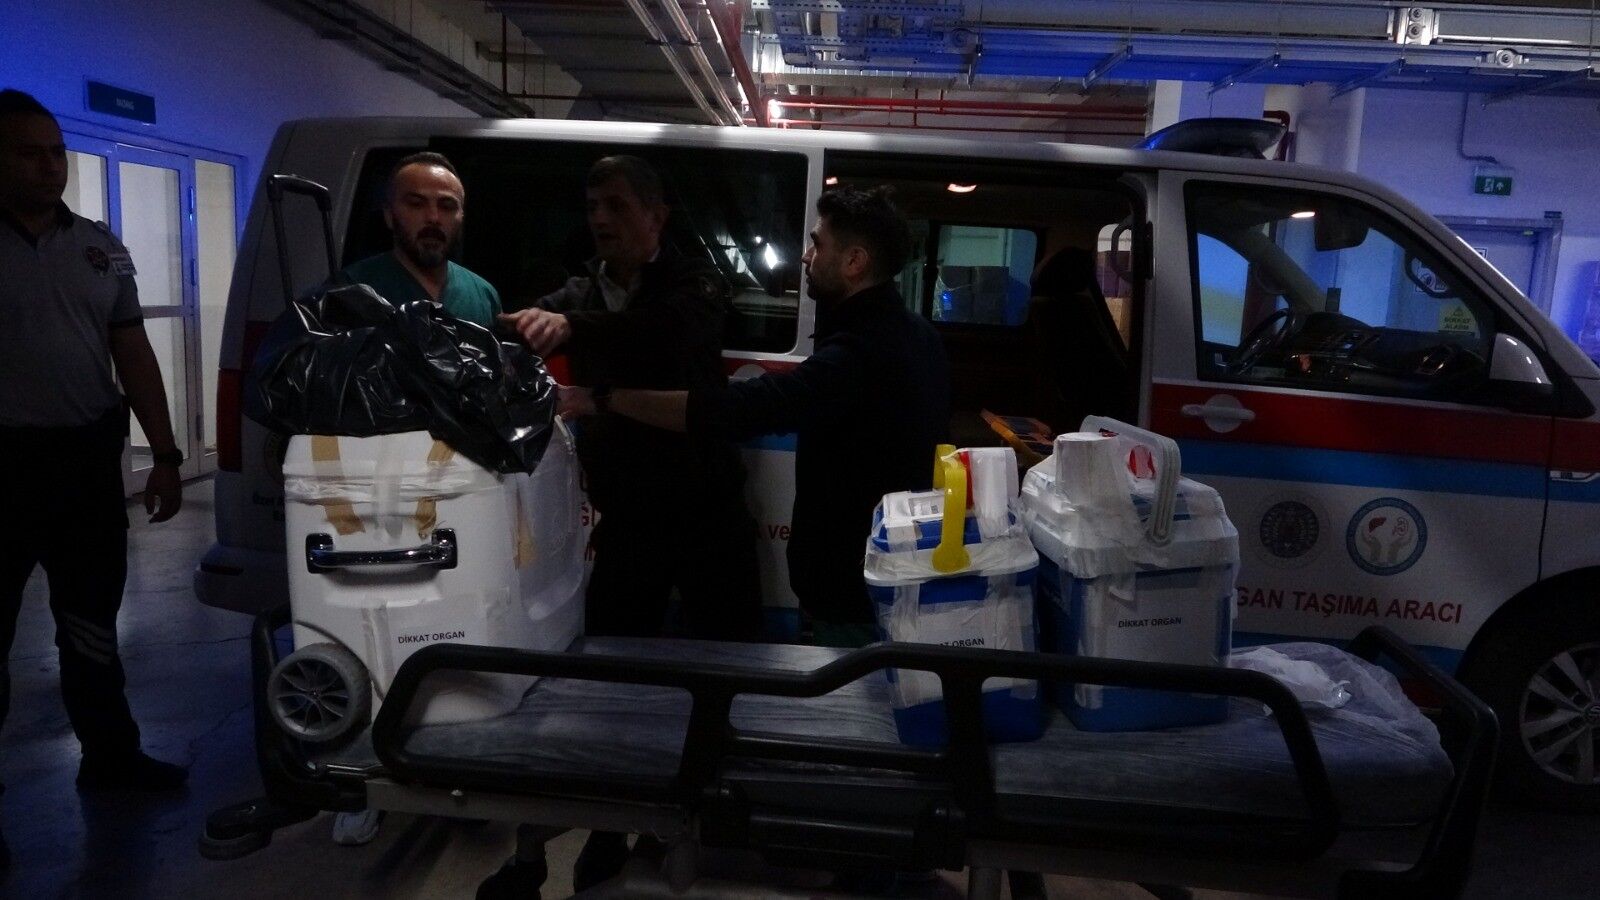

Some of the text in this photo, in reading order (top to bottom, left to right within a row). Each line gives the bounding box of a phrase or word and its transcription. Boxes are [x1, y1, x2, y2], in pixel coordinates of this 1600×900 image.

[1237, 586, 1463, 624] GAN TAŞIMA ARACI
[1151, 617, 1182, 626] ORGAN
[398, 631, 465, 644] DİKKAT ORGAN
[952, 637, 985, 648] ORGAN
